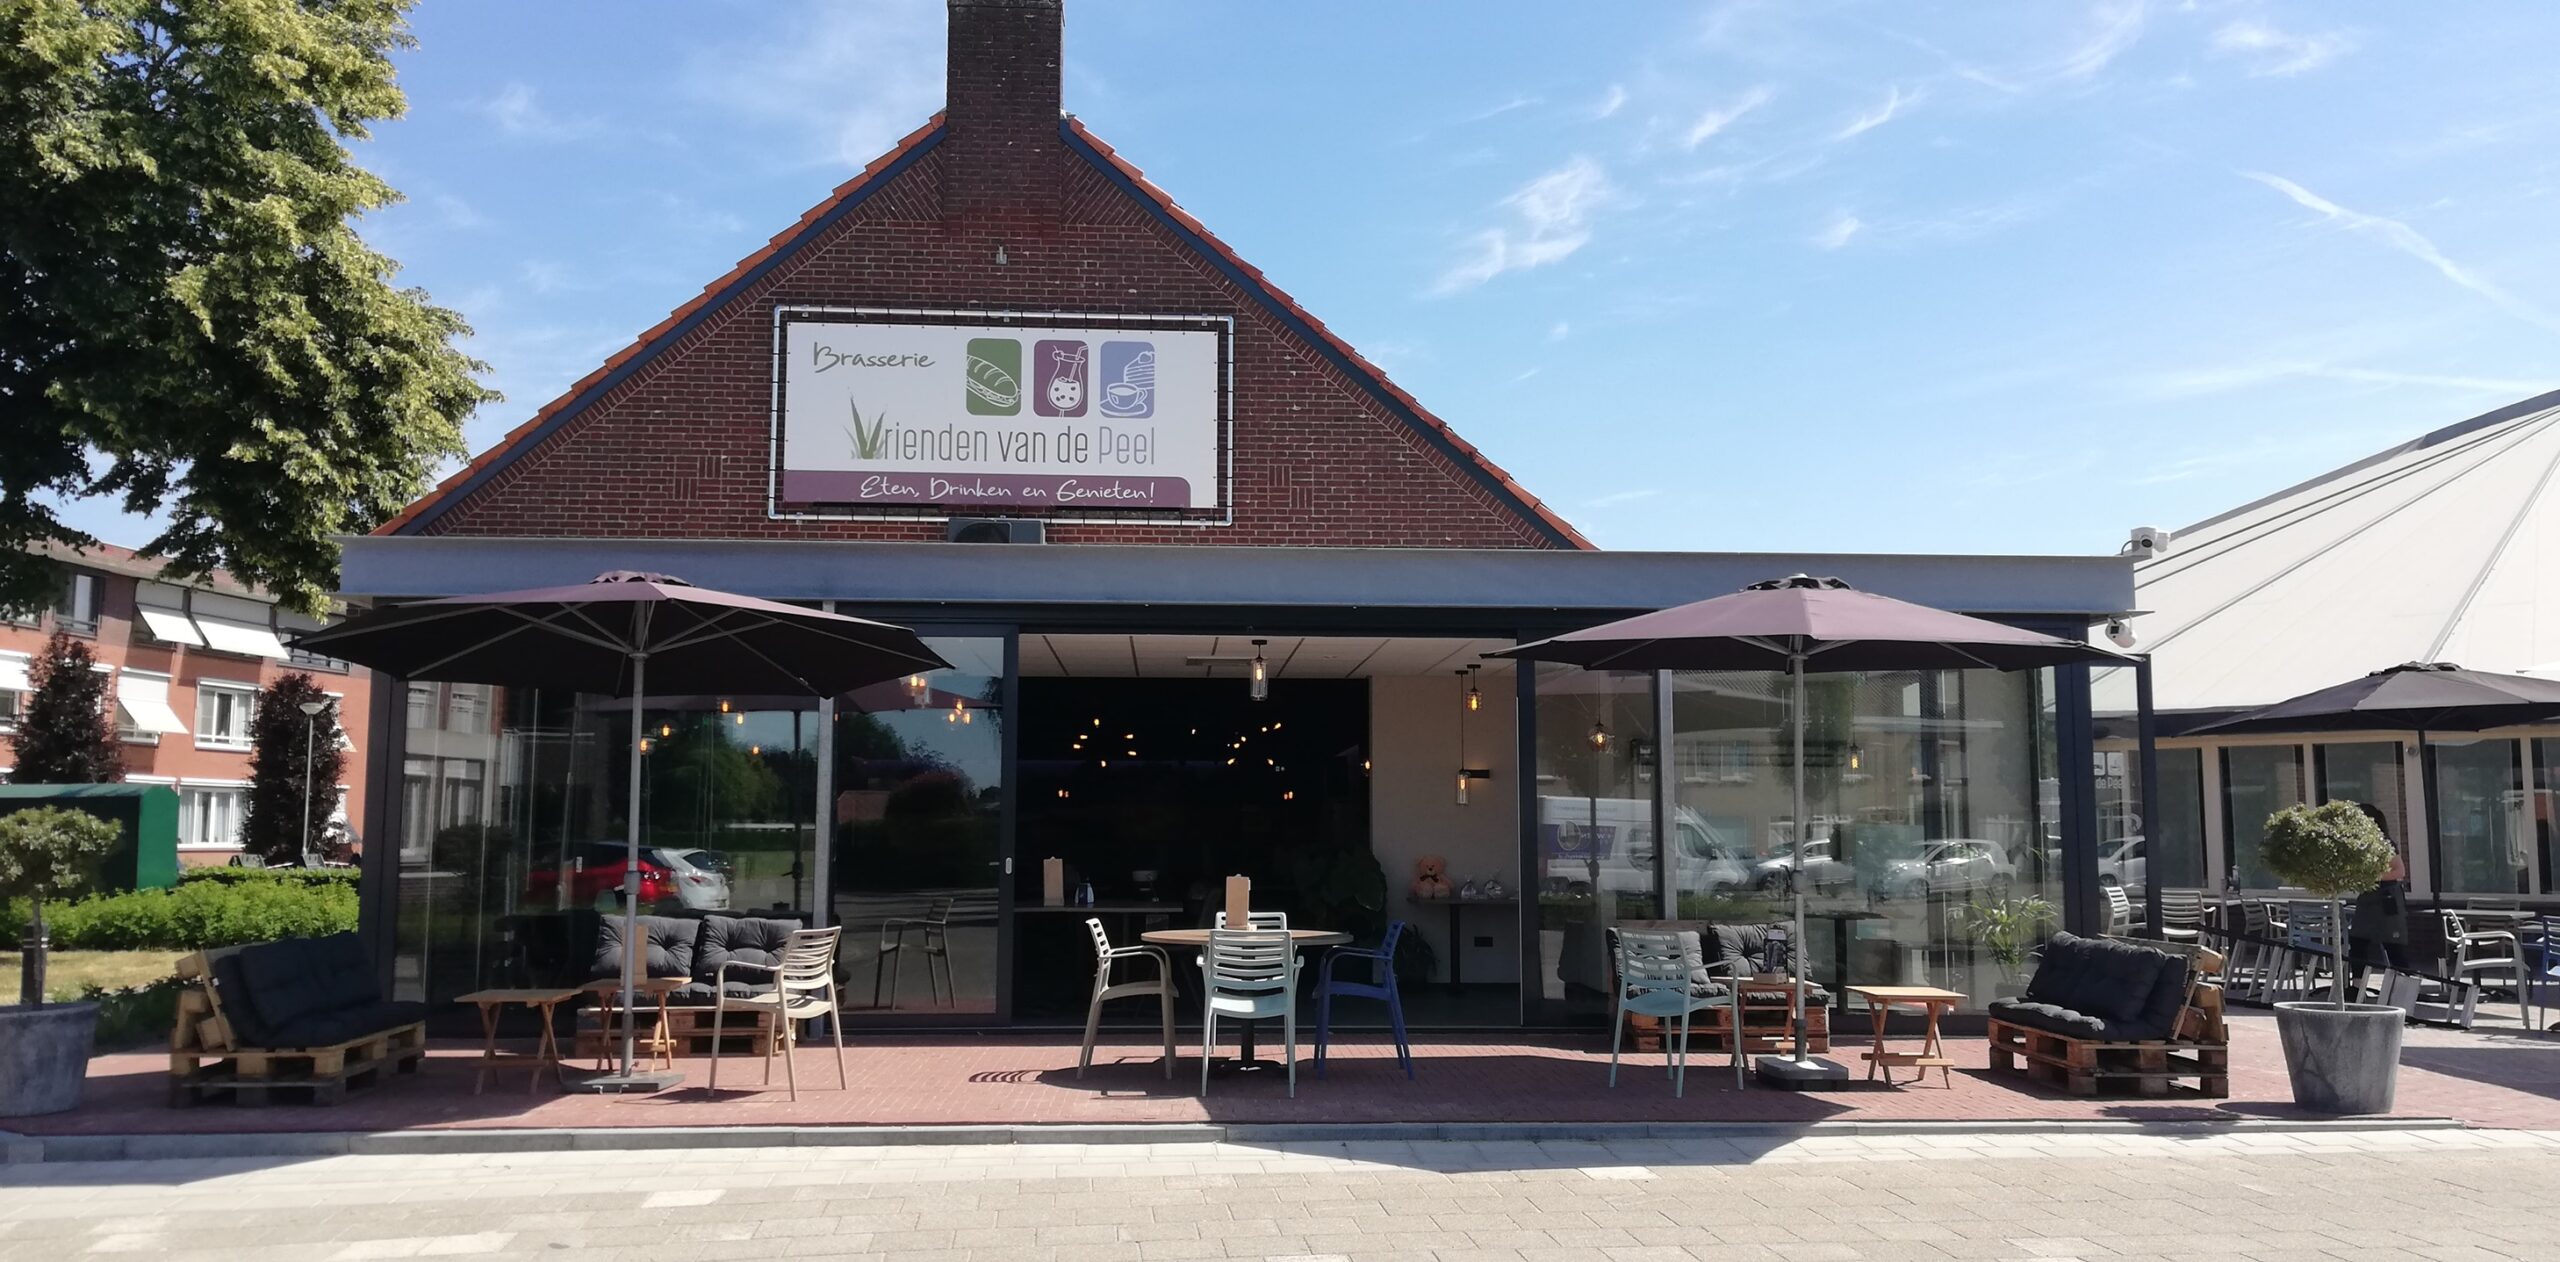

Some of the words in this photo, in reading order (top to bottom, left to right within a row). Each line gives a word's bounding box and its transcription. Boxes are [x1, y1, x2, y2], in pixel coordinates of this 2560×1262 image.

[813, 341, 936, 373] Brasserie
[848, 395, 988, 462] Vrienden
[997, 431, 1046, 463] van
[1057, 425, 1088, 464] de
[1099, 426, 1155, 465] Peel
[860, 475, 920, 498] Eten,
[929, 477, 1011, 500] Drinken
[1022, 486, 1047, 497] en
[1055, 479, 1155, 504] Genieten!
